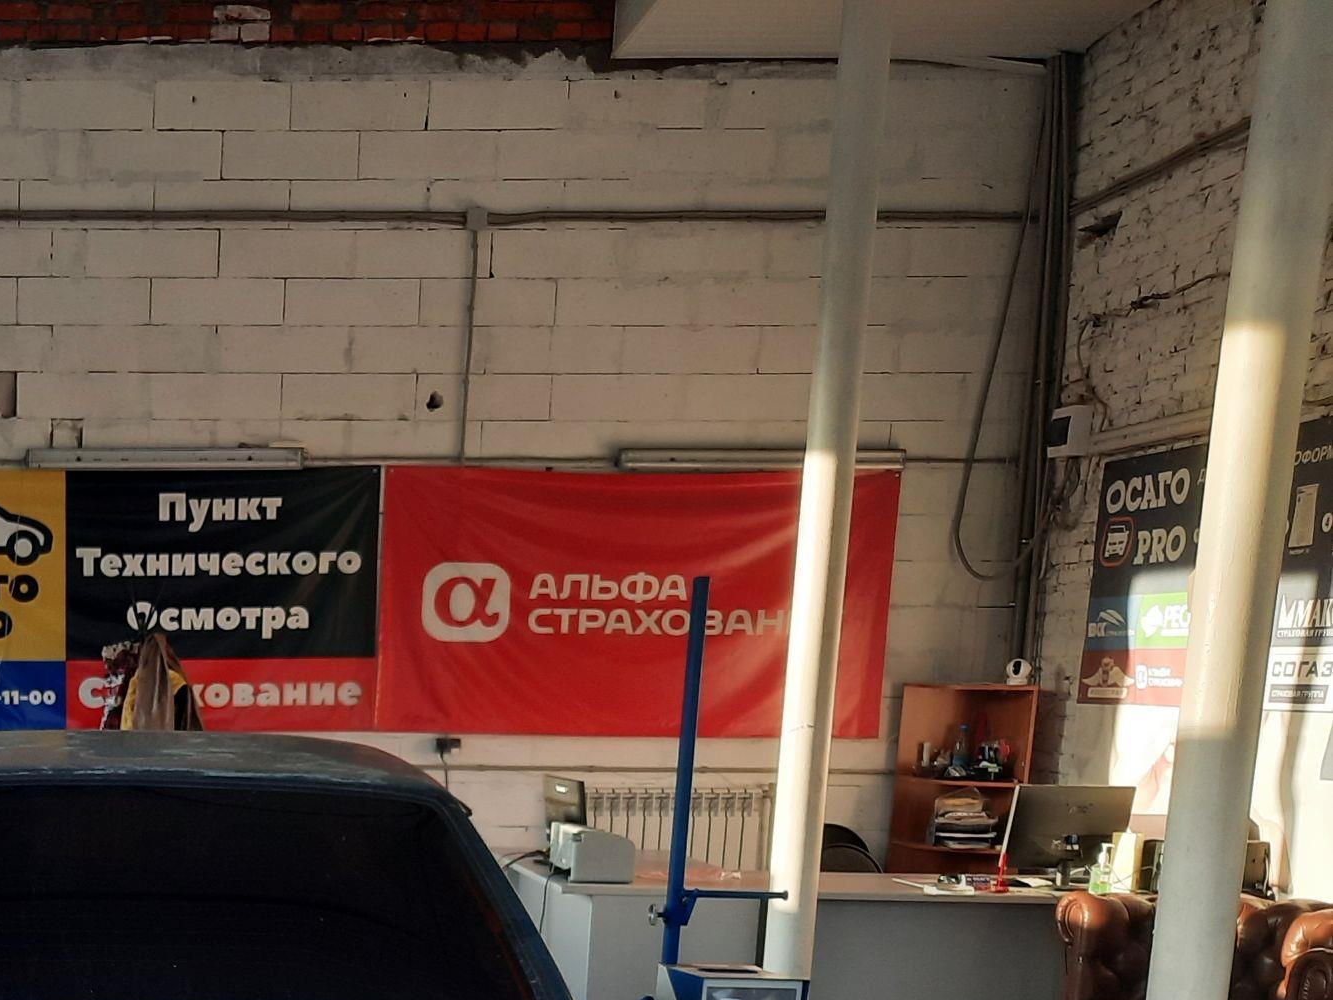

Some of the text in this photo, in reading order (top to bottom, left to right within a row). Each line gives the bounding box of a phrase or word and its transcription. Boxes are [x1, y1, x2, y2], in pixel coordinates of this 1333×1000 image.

[1106, 468, 1190, 514] ОСАГО
[158, 492, 283, 532] Пункт
[75, 547, 362, 577] Технического
[1133, 526, 1187, 565] PRO
[528, 572, 688, 603] АЛЬФА
[127, 601, 310, 639] Осмотра
[1272, 660, 1333, 678] СОГАЗ
[78, 677, 362, 709] Сование
